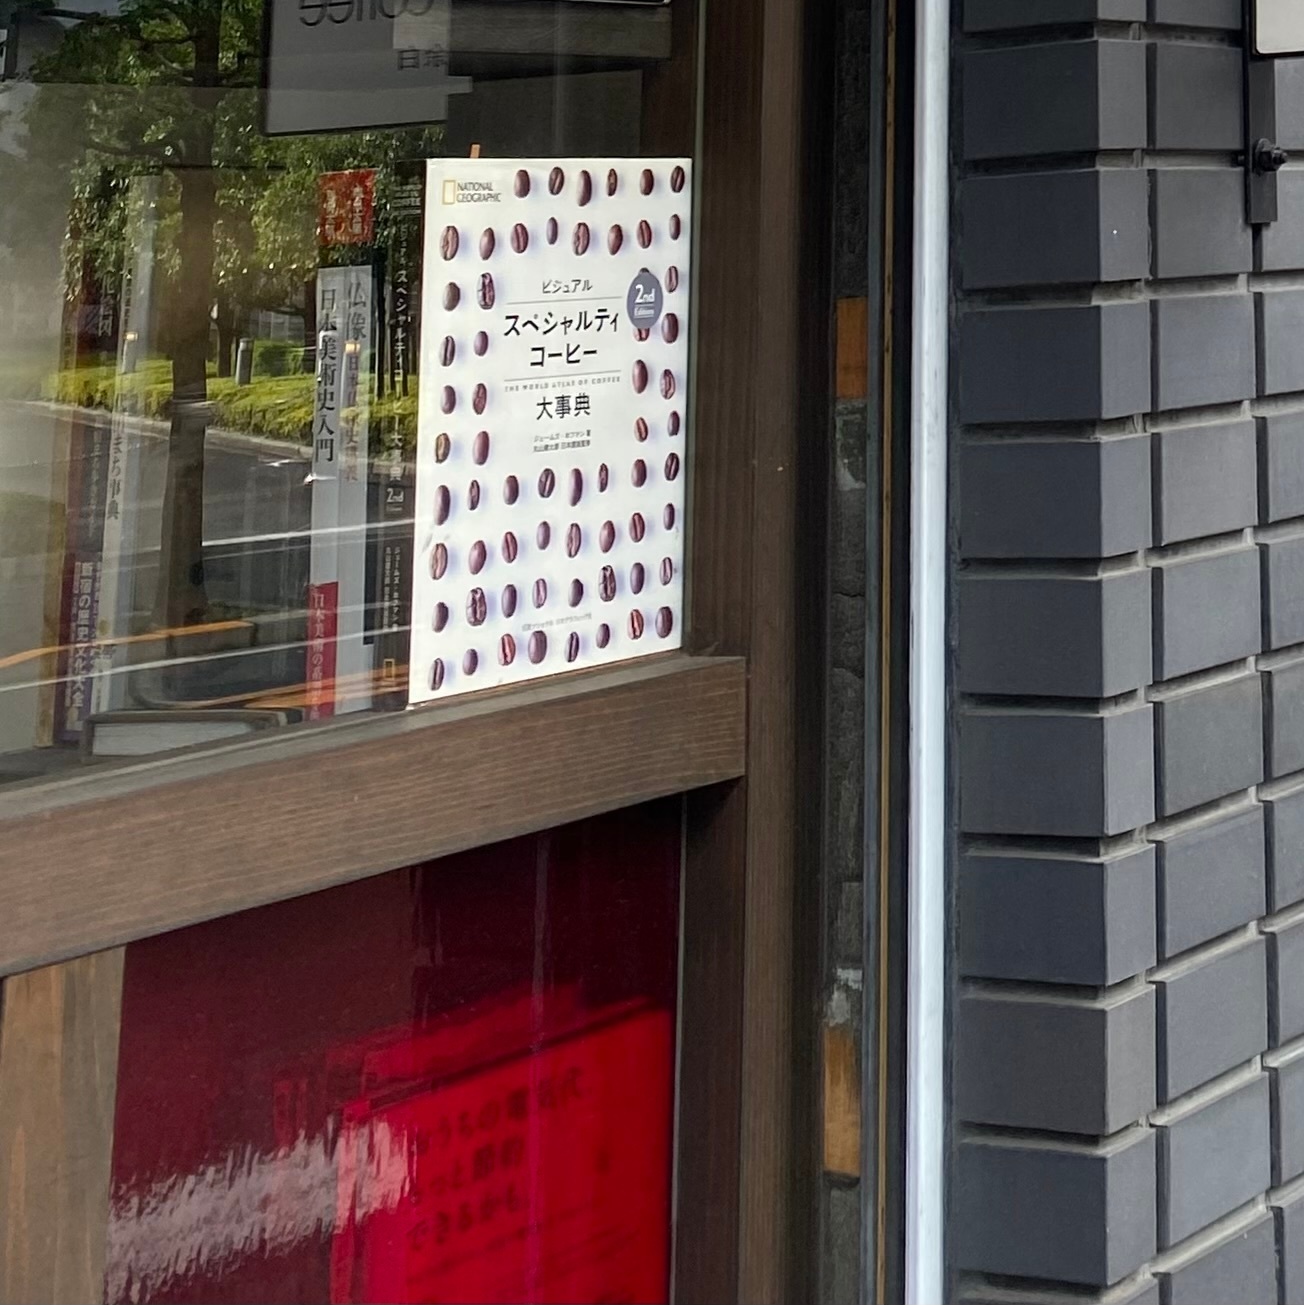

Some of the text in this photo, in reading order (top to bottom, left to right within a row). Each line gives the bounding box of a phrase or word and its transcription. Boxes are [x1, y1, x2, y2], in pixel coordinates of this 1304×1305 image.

[457, 182, 493, 192] NATIONAL
[542, 279, 593, 294] ビジュアル
[348, 282, 367, 342] 仏像
[504, 308, 619, 336] スペシャルティ
[530, 343, 597, 367] コーヒー
[315, 289, 337, 462] 日本美術史入門
[536, 393, 591, 421] 大事典
